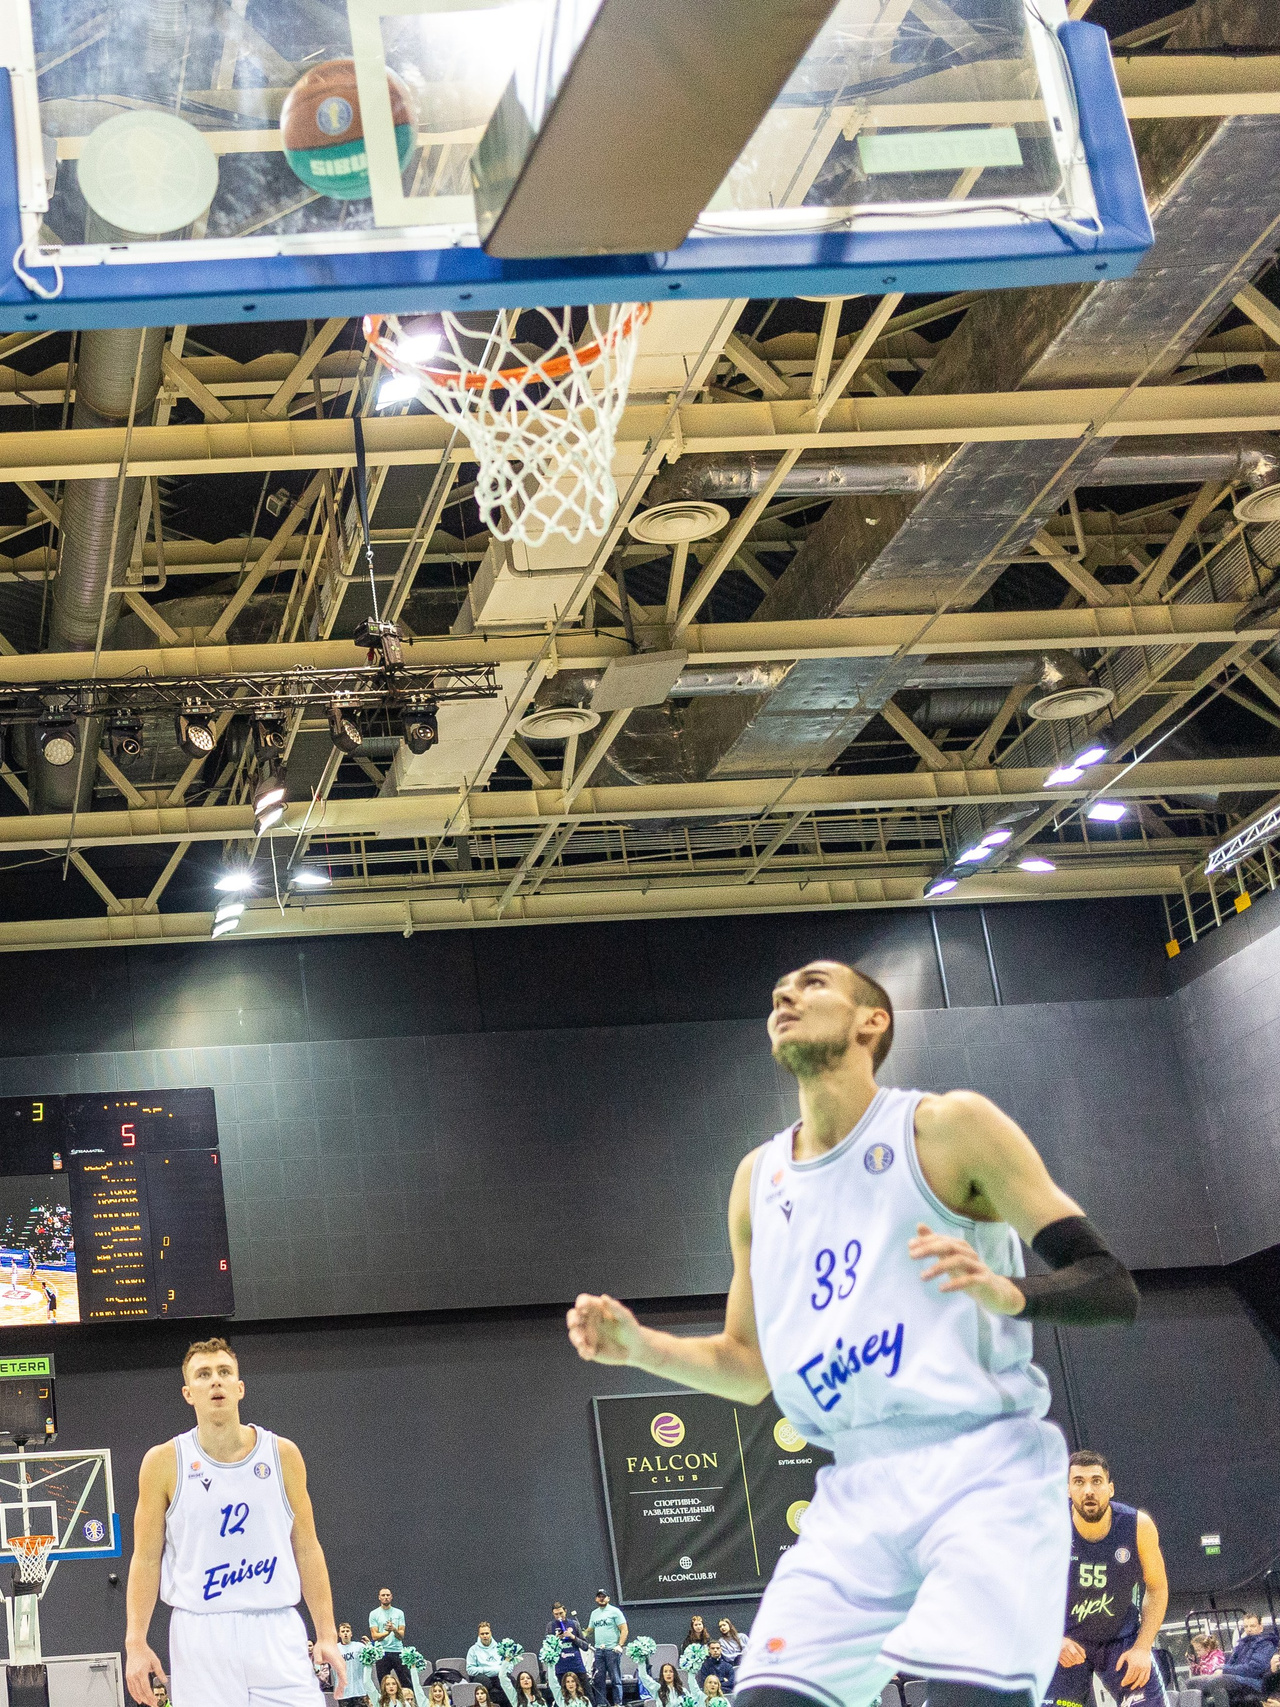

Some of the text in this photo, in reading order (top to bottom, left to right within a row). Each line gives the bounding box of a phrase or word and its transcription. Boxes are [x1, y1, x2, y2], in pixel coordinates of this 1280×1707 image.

[310, 153, 368, 176] SIBU
[121, 1124, 135, 1147] 5
[811, 1239, 862, 1311] 33
[797, 1322, 905, 1412] Enisey
[625, 1452, 718, 1473] FALCON
[651, 1474, 699, 1483] CLUB
[643, 1505, 715, 1516] РАЗВЛЕКАТЕЛЬНЫЙ
[653, 1498, 702, 1507] СПОРТИВНО-
[220, 1502, 250, 1538] 12
[659, 1515, 702, 1524] КОМПЛЕКС
[203, 1556, 278, 1601] Enisey
[658, 1572, 717, 1582] FALCONCLUB.BY
[1079, 1563, 1107, 1588] 55
